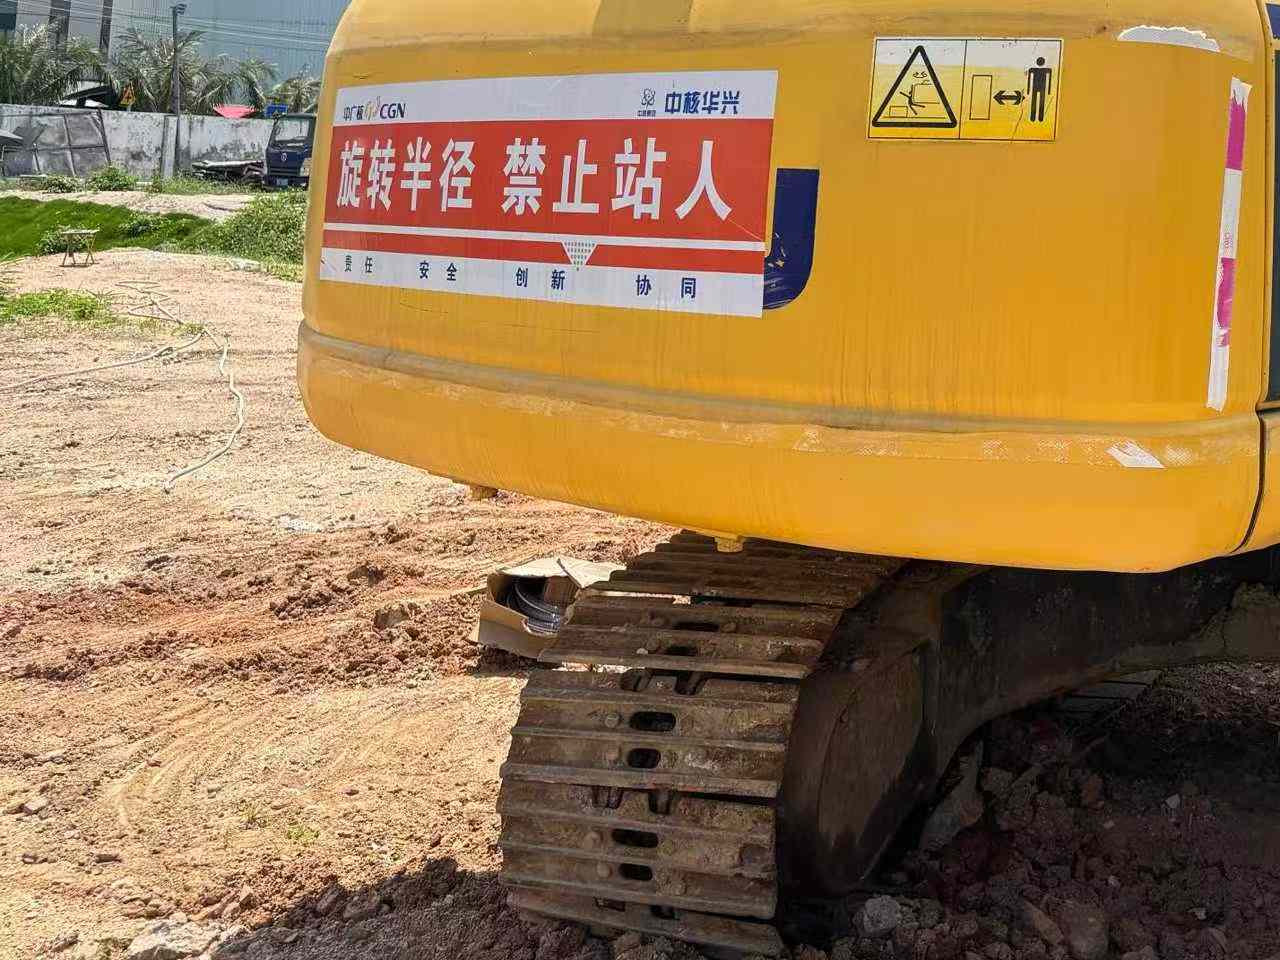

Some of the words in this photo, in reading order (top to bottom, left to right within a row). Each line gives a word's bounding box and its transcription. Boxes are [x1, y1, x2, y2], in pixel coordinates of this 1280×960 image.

[380, 103, 407, 119] CGN
[664, 90, 741, 115] 中核华兴
[336, 136, 477, 213] 旋转半径
[500, 136, 733, 221] 禁止站人
[418, 259, 458, 282] 安全
[515, 266, 566, 291] 创新
[635, 274, 698, 300] 协同
